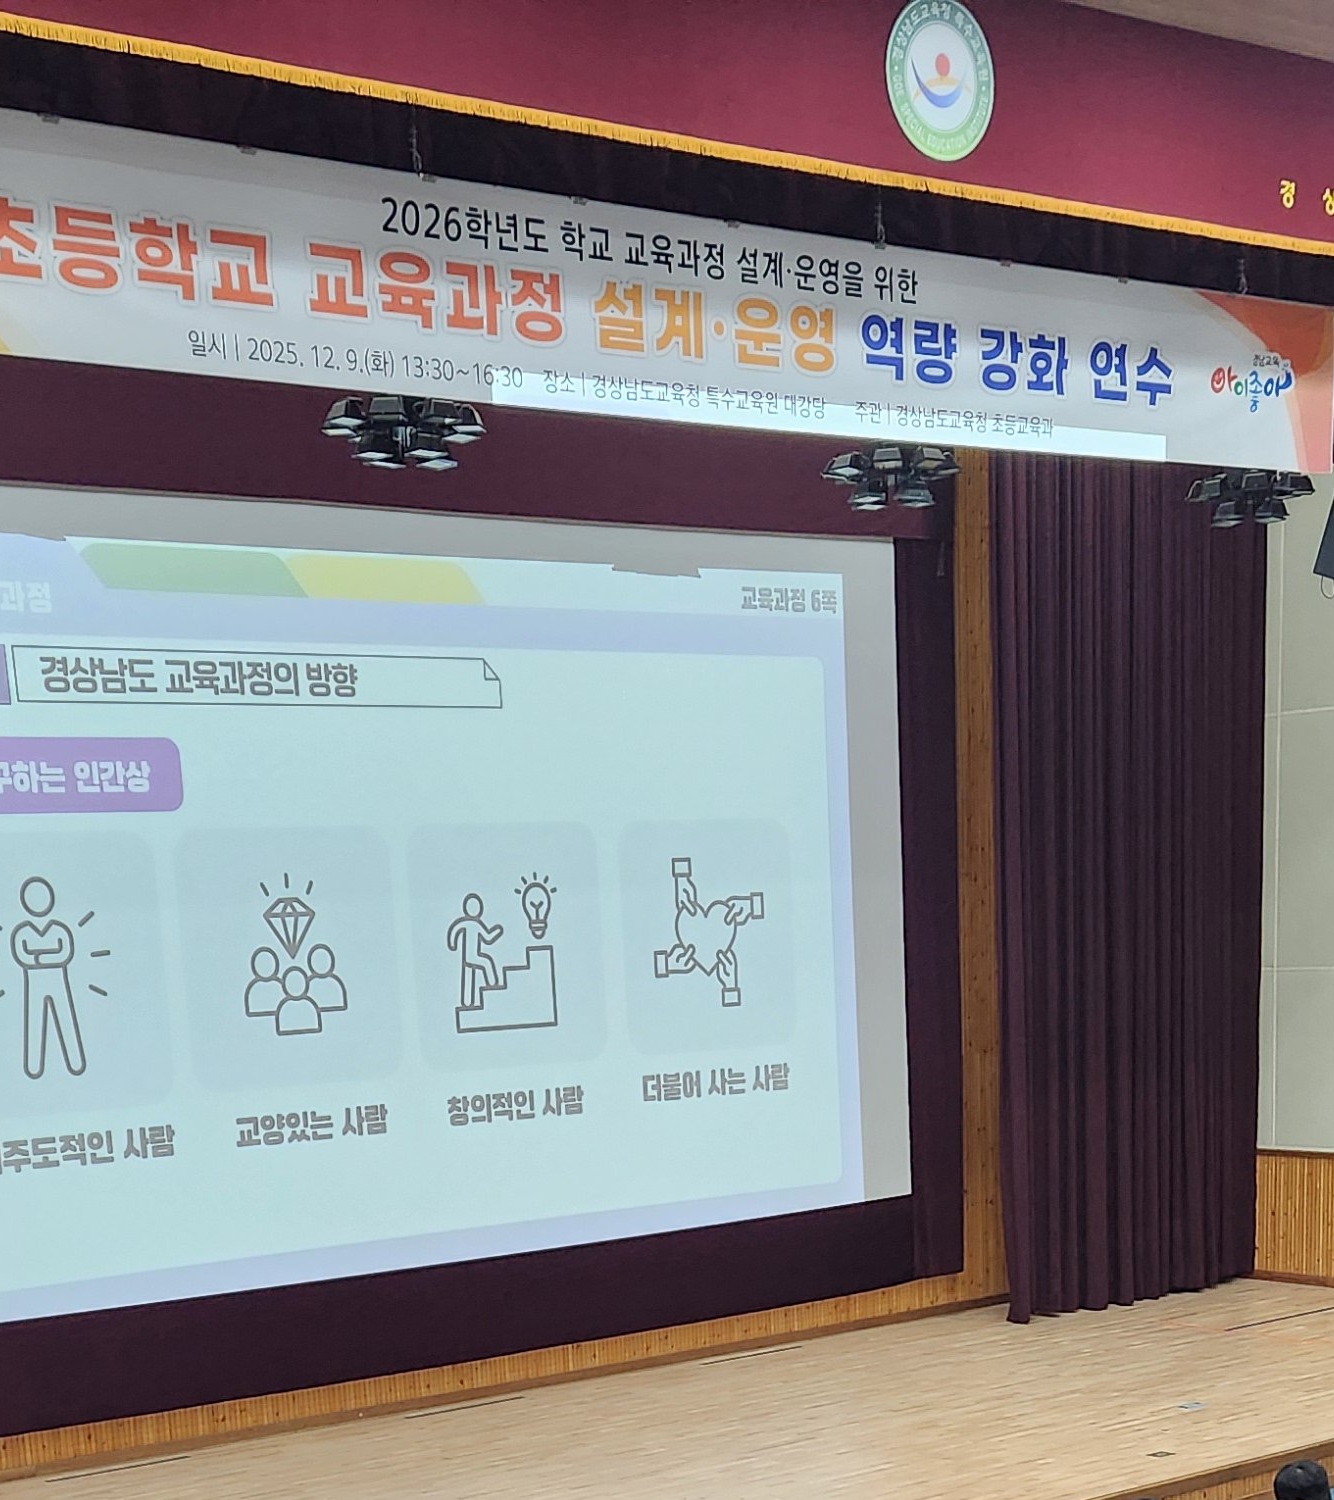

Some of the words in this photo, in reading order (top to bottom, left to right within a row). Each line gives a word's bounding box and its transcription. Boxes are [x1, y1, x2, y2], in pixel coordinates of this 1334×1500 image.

[381, 197, 549, 255] 2026학년도
[561, 221, 613, 263] 학교
[624, 228, 726, 282] 교육과정
[874, 266, 919, 305] 위한
[307, 242, 563, 342] 교육과정
[594, 281, 837, 374] 설계·운영
[862, 313, 958, 382] 역량
[980, 329, 1069, 398] 강화
[1090, 343, 1174, 408] 연수
[187, 330, 227, 361] 일시
[247, 338, 304, 367] 2025.
[311, 344, 341, 371] 12.
[402, 355, 524, 389] 13:30~16:30
[543, 369, 575, 396] 장소
[592, 375, 700, 408] 경상남도교육청
[706, 385, 778, 415] 특수교육원
[784, 394, 827, 420] 대강당
[854, 401, 883, 425] 주관
[896, 405, 988, 434] 경상남도교육청
[992, 413, 1055, 438] 초등교육과
[741, 586, 806, 614] 교육과정
[810, 588, 837, 615] 6쪽
[40, 655, 158, 694] 경상남도
[164, 658, 300, 697] 교육과정의
[305, 662, 358, 698] 방향
[73, 761, 151, 794] 인간상
[642, 1070, 702, 1102] 더불어
[707, 1067, 747, 1097] 사는
[752, 1062, 790, 1092] 사람
[236, 1111, 333, 1148] 교양있는
[342, 1103, 388, 1136] 사람
[447, 1088, 535, 1127] 창의적인
[542, 1085, 584, 1116] 사람
[124, 1124, 175, 1160] 사람
